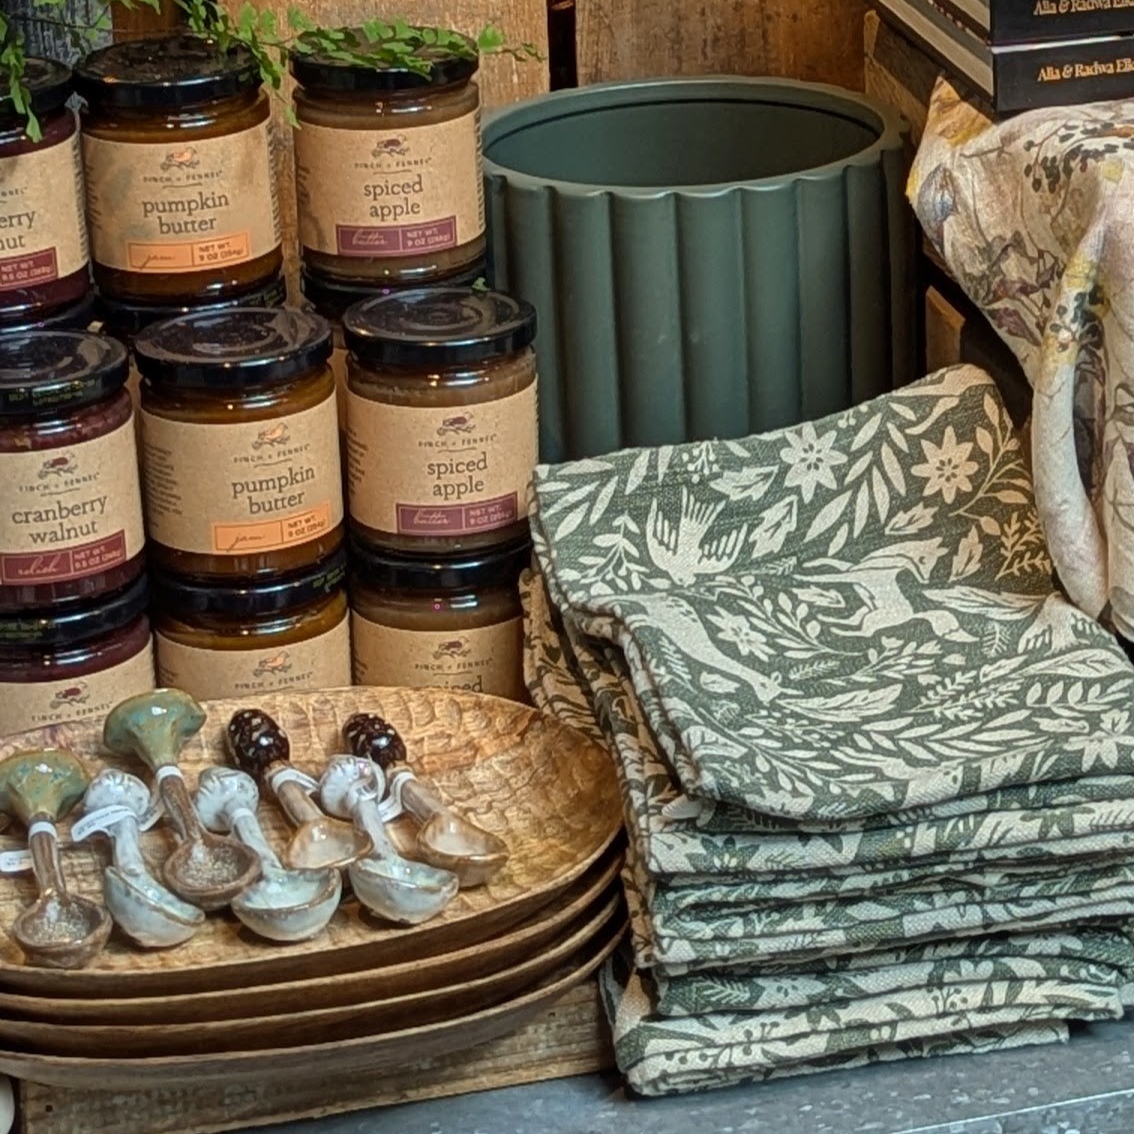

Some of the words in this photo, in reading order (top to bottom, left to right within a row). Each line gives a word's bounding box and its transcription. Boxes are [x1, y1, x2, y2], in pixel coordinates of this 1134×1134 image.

[1062, 64, 1074, 79] &
[1075, 60, 1115, 78] Radwa
[364, 174, 424, 201] spiced
[142, 191, 230, 217] pumpkin
[369, 198, 421, 222] apple
[158, 216, 217, 235] butter
[415, 239, 425, 247] OZ
[427, 452, 488, 480] spiced
[231, 466, 315, 499] pumpkin
[433, 477, 484, 501] apple
[12, 495, 108, 525] cranberry
[249, 491, 305, 515] butter
[29, 521, 98, 545] walnut
[288, 519, 302, 528] NET
[295, 527, 306, 536] OZ
[74, 550, 90, 559] NET
